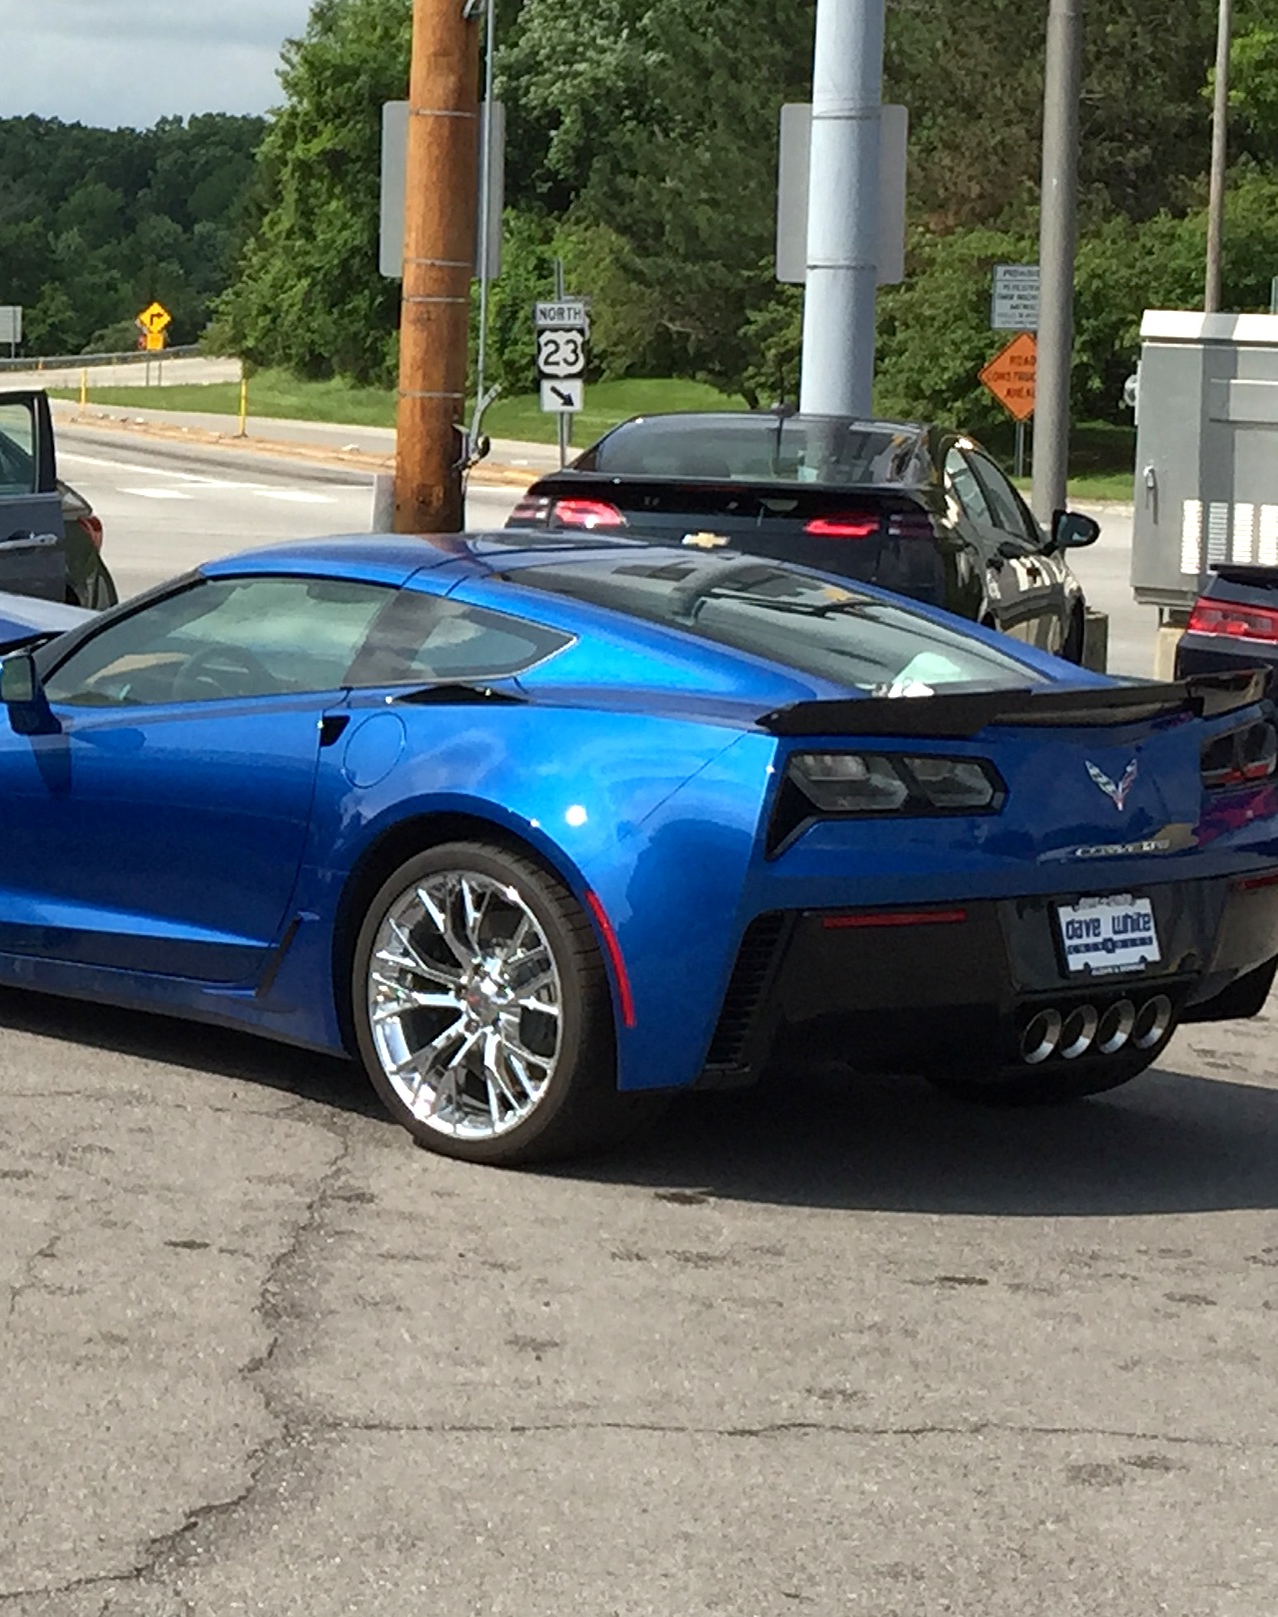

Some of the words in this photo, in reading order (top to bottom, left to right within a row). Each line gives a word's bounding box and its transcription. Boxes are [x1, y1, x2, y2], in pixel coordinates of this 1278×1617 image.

[539, 307, 581, 321] NORTH
[543, 338, 580, 367] 23
[1009, 355, 1037, 366] ROAD
[986, 371, 1036, 382] CONSTRUC
